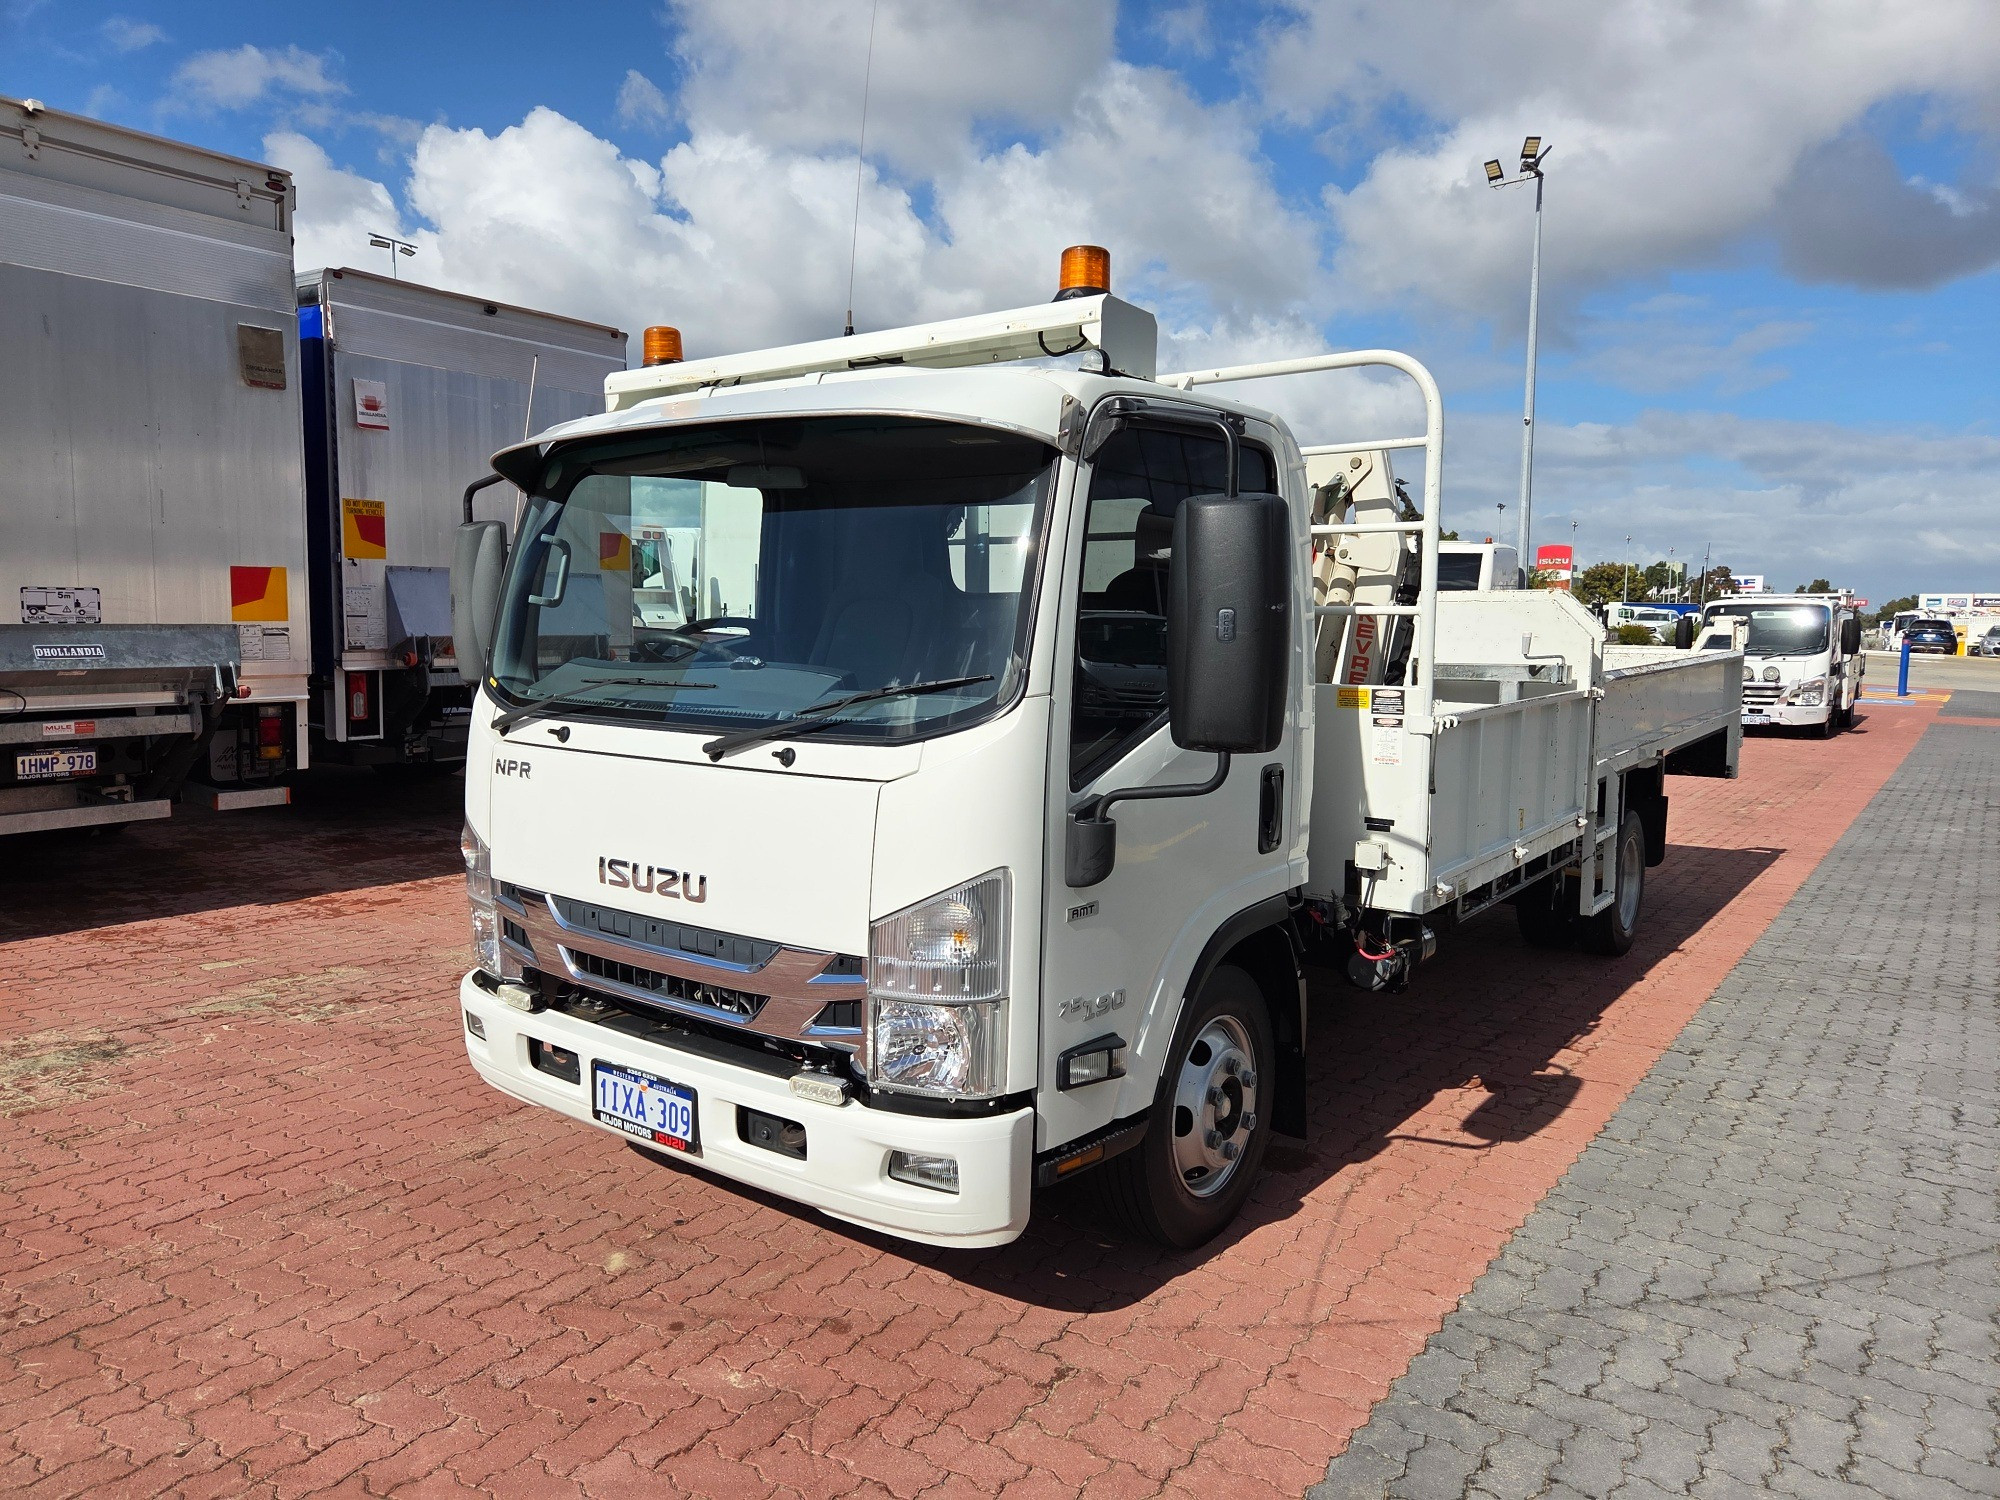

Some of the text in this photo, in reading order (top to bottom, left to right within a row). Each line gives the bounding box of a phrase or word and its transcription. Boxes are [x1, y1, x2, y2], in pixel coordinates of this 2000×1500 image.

[1538, 557, 1569, 565] ISUZU
[57, 591, 71, 599] 5m
[35, 647, 104, 657] DHOLLANDIA
[495, 757, 532, 779] NPR
[598, 855, 708, 904] ISUZU
[1071, 904, 1096, 919] AMT
[612, 1069, 677, 1096] WESTERN AUSTRALIA
[600, 1112, 686, 1151] MAJOR MOTORS ISUZU
